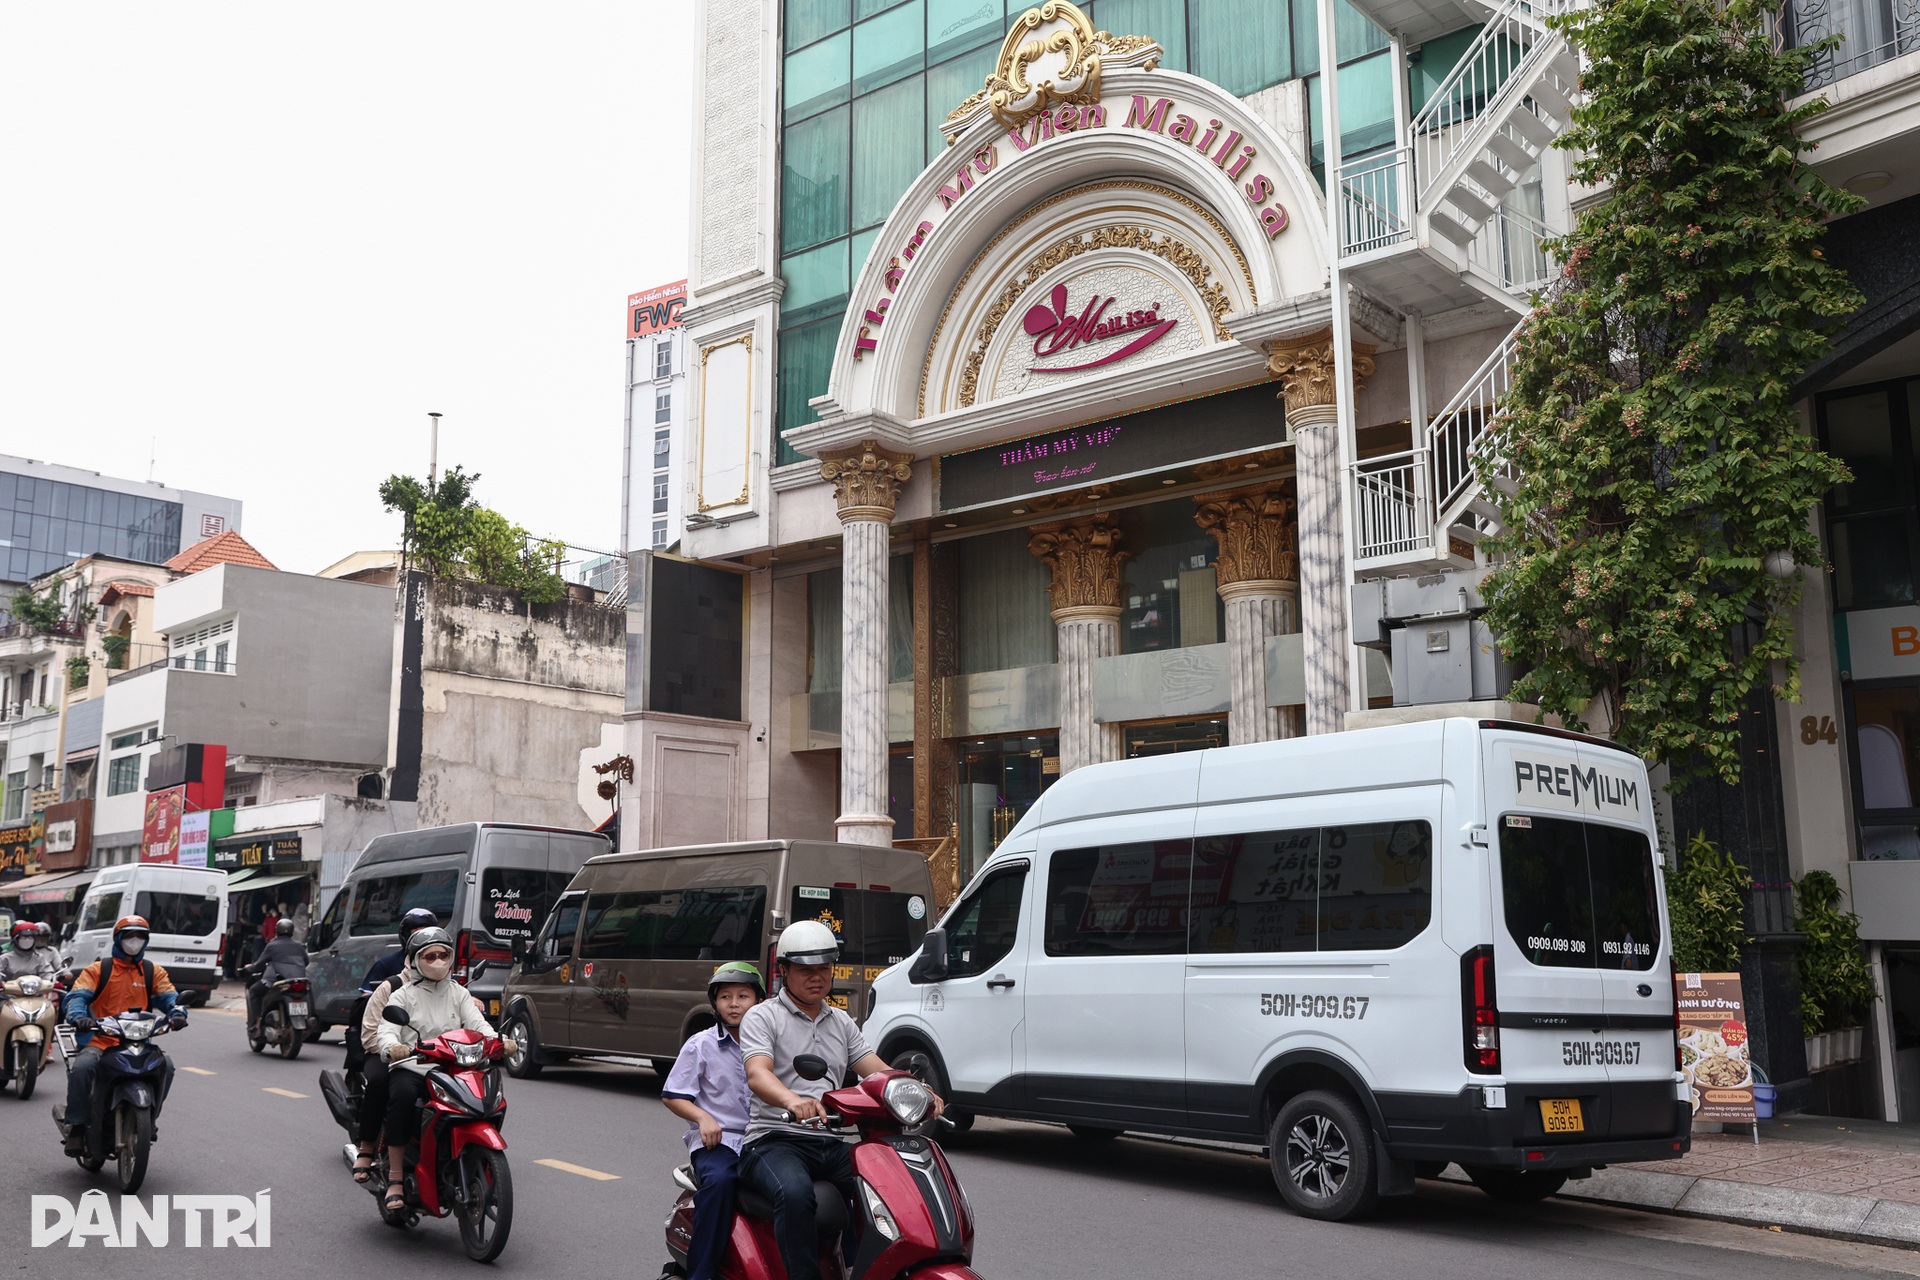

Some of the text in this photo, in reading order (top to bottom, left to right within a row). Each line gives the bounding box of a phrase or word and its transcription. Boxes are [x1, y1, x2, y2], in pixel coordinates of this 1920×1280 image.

[1007, 101, 1107, 152] Viện
[1123, 94, 1291, 240] Mailisa
[1800, 715, 1838, 746] 84
[1515, 760, 1640, 814] PREMIUM
[276, 839, 298, 849] TUẤN
[241, 843, 263, 865] TUẤN
[490, 888, 521, 900] Du Lịch
[494, 901, 533, 924] Hoàng
[1527, 935, 1586, 953] 0909.099 308
[1603, 941, 1650, 956] 0931.92 4146
[1687, 973, 1699, 986] BSG
[1697, 988, 1709, 997] CÓ
[1260, 993, 1370, 1020] 50H-909.67
[1701, 997, 1741, 1010] DƯỠNG
[1726, 1034, 1745, 1042] 45%
[1562, 1041, 1641, 1066] 50H-909.67
[1552, 1101, 1571, 1115] 50H
[1547, 1116, 1580, 1131] 909.67
